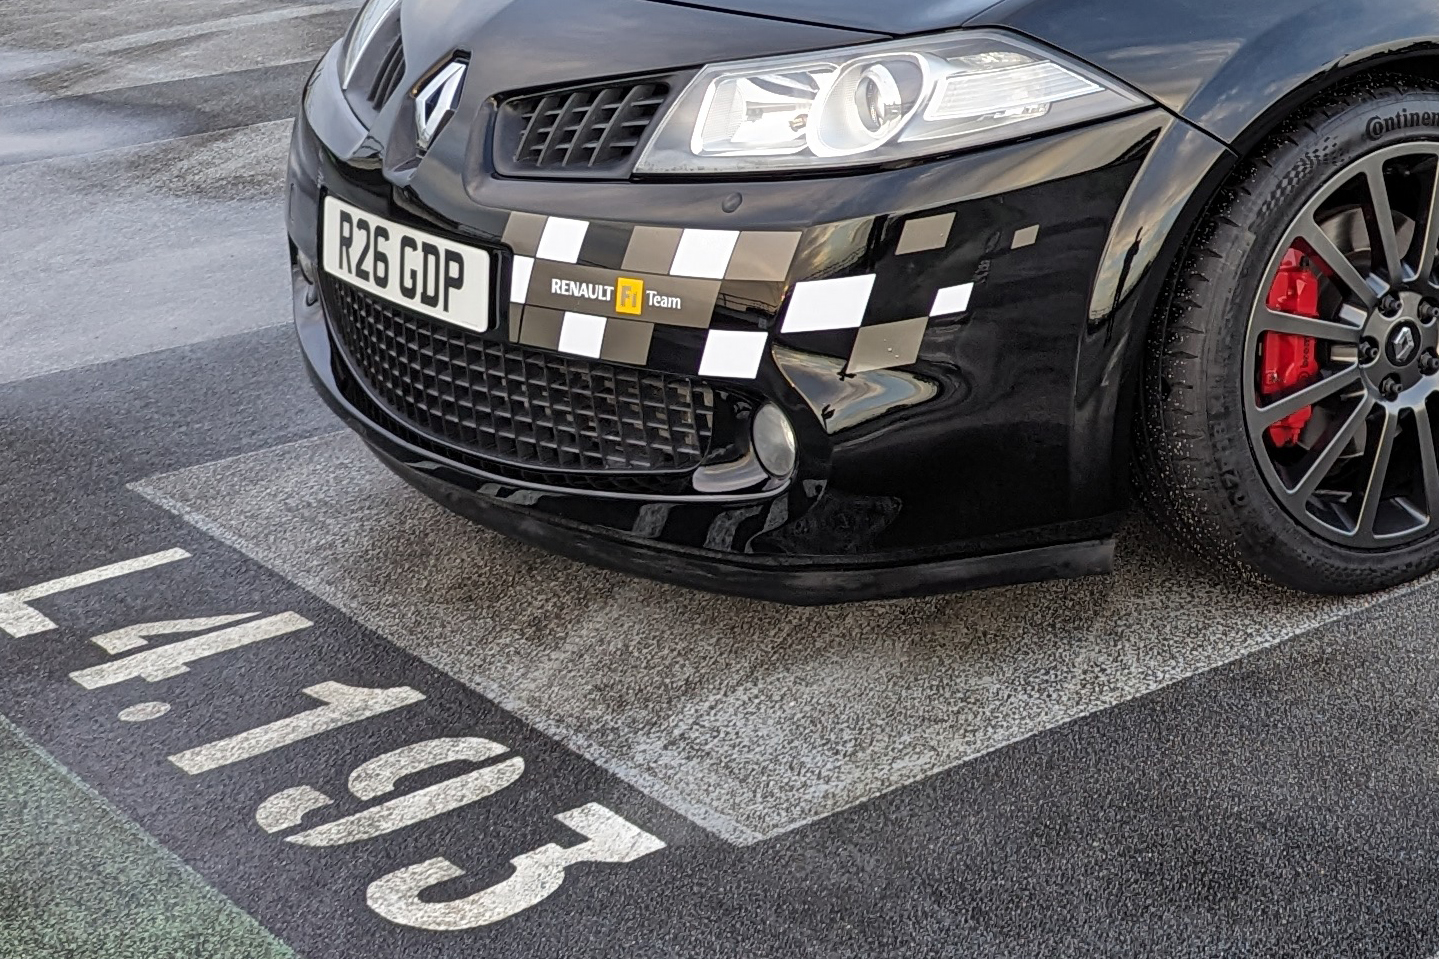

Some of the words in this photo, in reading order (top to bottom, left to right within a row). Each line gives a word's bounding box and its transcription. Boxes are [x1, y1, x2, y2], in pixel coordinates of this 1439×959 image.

[339, 209, 390, 289] R26
[400, 234, 465, 313] GDP
[551, 278, 614, 301] RENAULT
[646, 290, 682, 309] Team
[0, 547, 667, 930] L4.193
